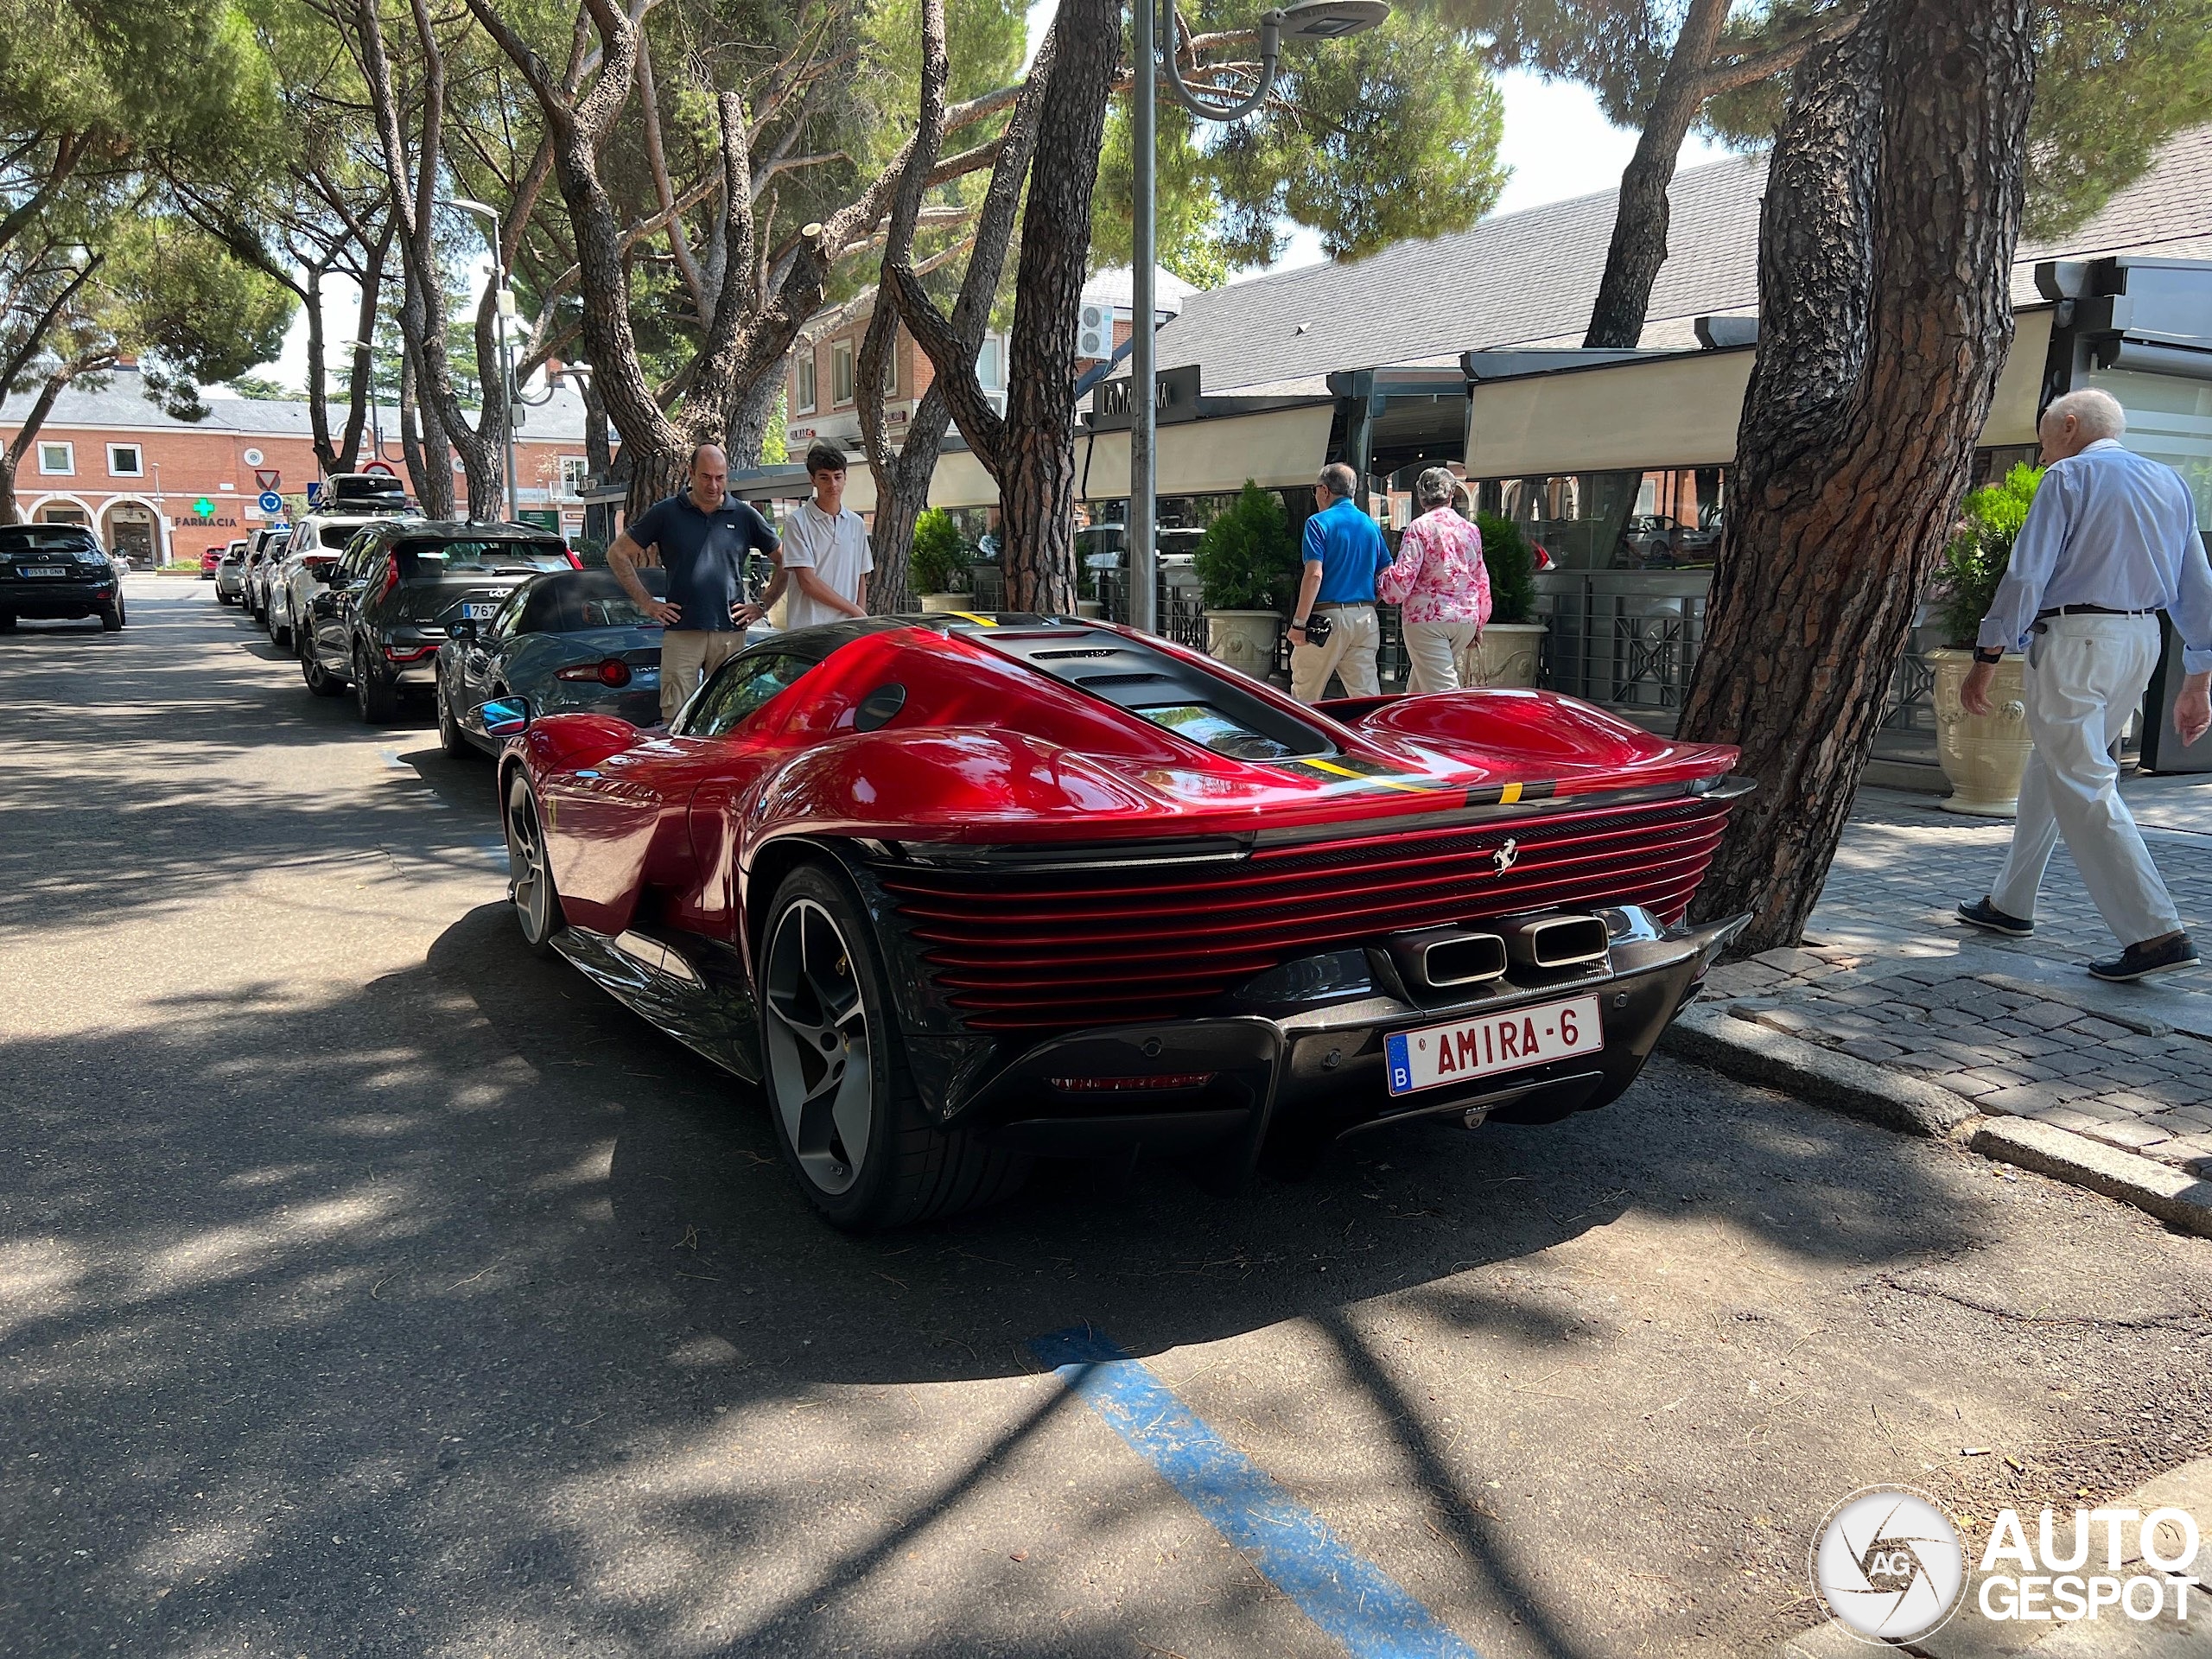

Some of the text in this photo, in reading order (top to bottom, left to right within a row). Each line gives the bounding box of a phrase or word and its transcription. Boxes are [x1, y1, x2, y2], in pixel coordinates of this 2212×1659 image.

[175, 518, 237, 527] FARMACIA
[1438, 1008, 1579, 1075] AMIRA-6
[1395, 1067, 1408, 1087] B
